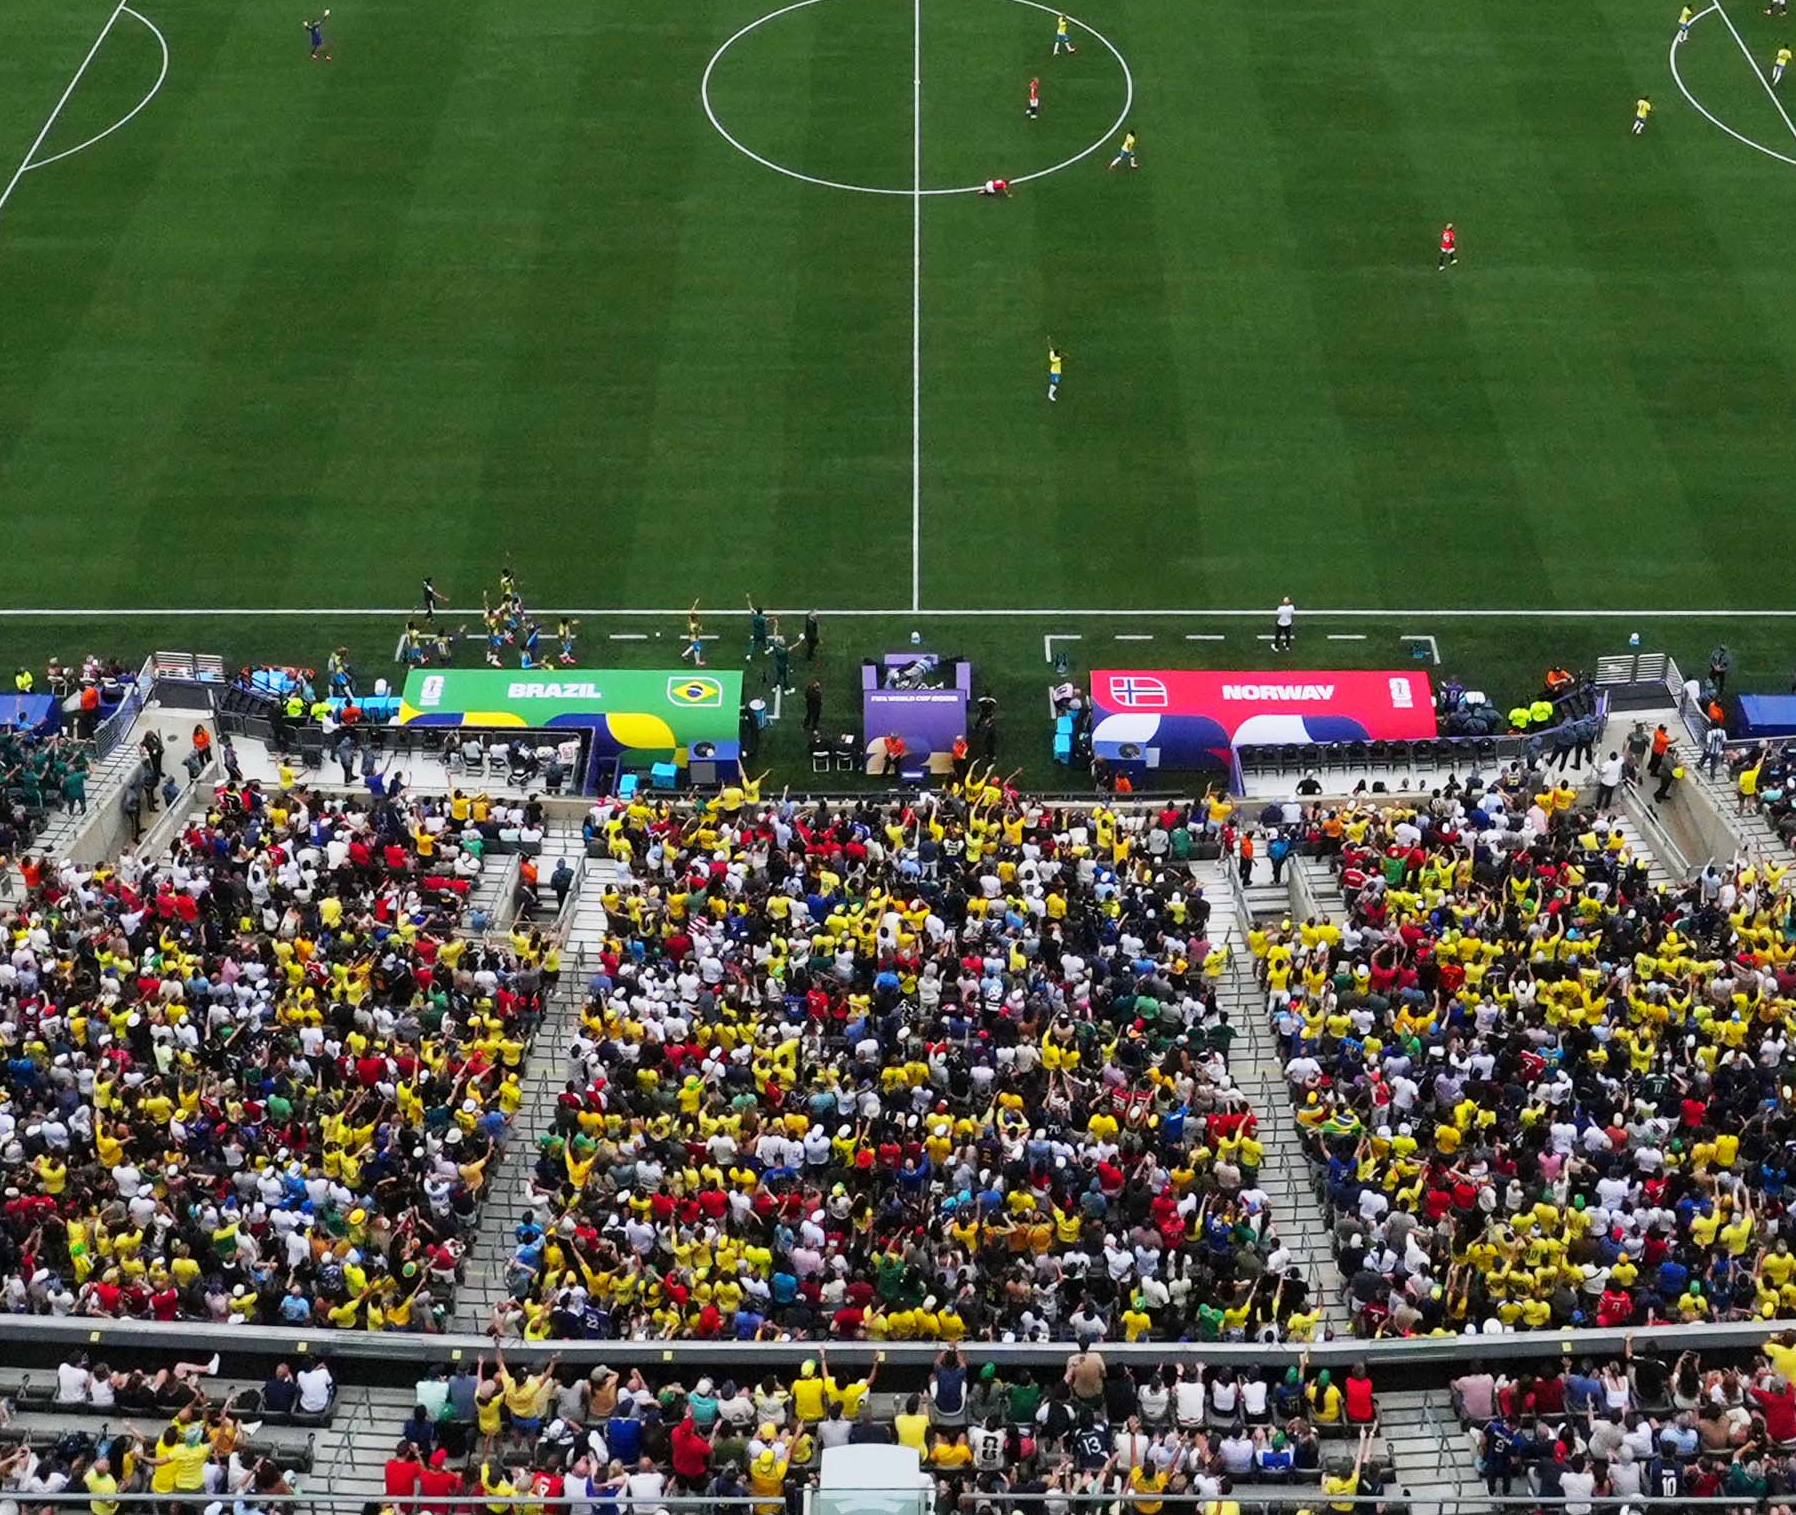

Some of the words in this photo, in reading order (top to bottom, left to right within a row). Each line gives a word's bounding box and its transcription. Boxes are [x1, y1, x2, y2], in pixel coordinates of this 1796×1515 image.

[507, 682, 602, 699] BRAZIL
[1221, 684, 1335, 701] NORWAY
[1083, 1435, 1103, 1456] 13
[1661, 1476, 1676, 1497] 10
